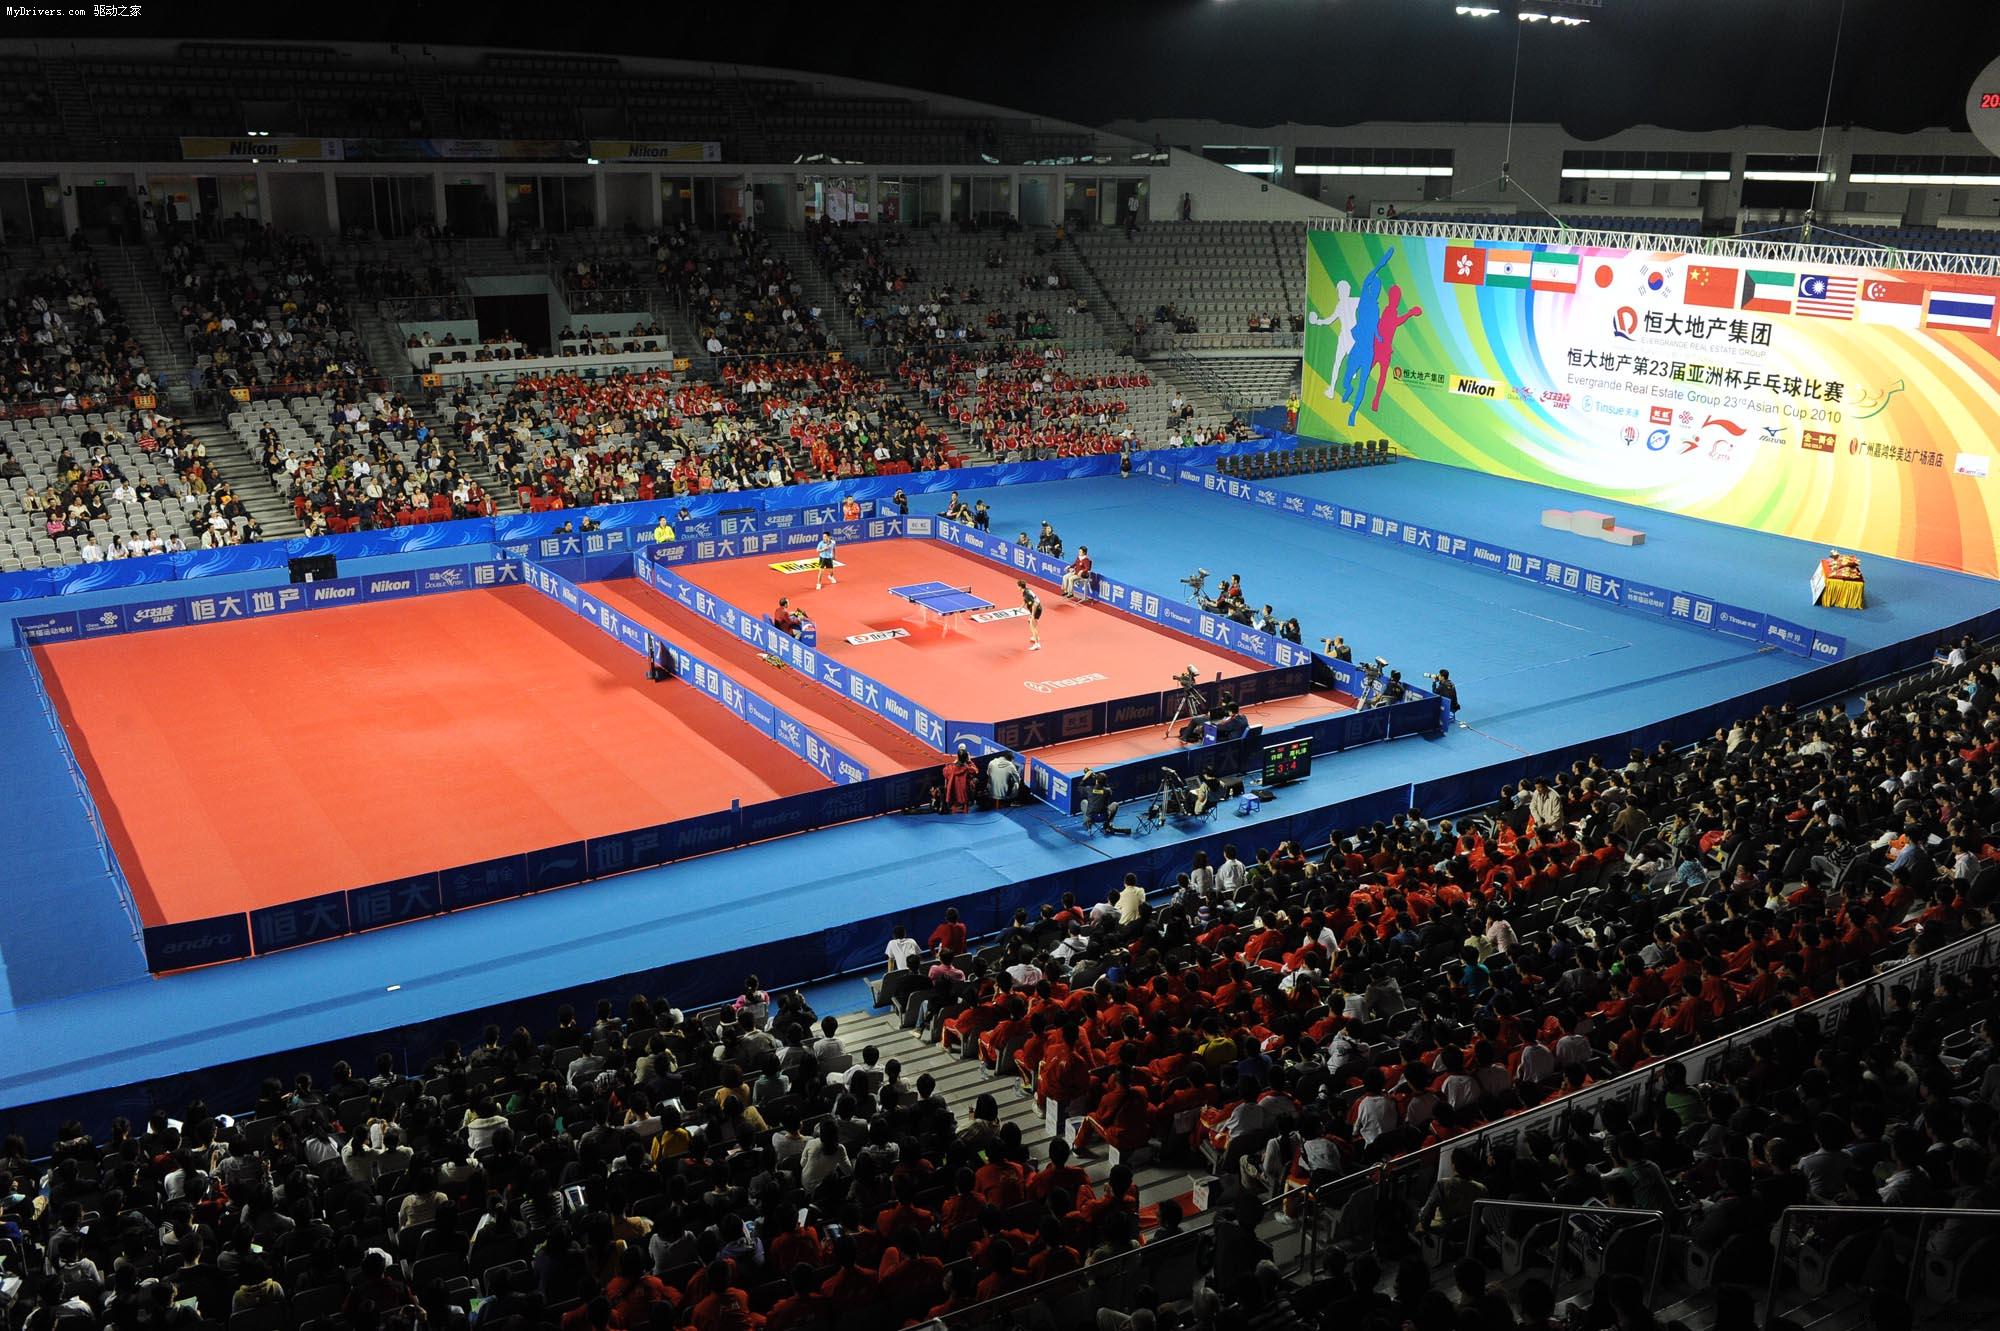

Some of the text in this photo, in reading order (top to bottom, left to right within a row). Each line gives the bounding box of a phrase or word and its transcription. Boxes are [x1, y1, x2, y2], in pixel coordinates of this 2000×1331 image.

[230, 141, 278, 156] Nikon
[628, 144, 668, 158] Nikon
[138, 185, 147, 196] A
[1261, 184, 1269, 192] B
[1377, 207, 1385, 215] C
[1644, 308, 1773, 347] 恒大地产集团
[1690, 342, 1707, 352] REAL
[1710, 345, 1737, 356] ESTATE
[1739, 348, 1767, 358] GROUP
[1403, 368, 1445, 384] 恒大地产集团
[1567, 347, 1845, 404] 恒大地产第23届亚洲杯乒乓球比赛
[1457, 378, 1496, 398] Nikon
[1567, 373, 1622, 392] Evergrande
[1625, 382, 1648, 395] Real
[1651, 385, 1684, 400] Estate
[1687, 390, 1721, 407] Group
[1747, 399, 1781, 414] Asian
[1783, 404, 1808, 420] Cup
[1811, 409, 1842, 424] 2010
[1180, 469, 1200, 483] Nikon
[1204, 474, 1226, 493] 恒大
[1228, 480, 1251, 501] 恒大
[721, 516, 757, 535] 恒大
[803, 507, 836, 527] 恒大
[869, 518, 902, 538] 恒大
[1339, 509, 1366, 529] 地产
[1371, 516, 1398, 537] 地产
[586, 531, 624, 554] 地产
[742, 533, 778, 554] 地产
[788, 533, 819, 545] Nikon
[939, 520, 960, 544] 恒大
[964, 532, 984, 550] Nikon
[1402, 525, 1431, 548] 恒大
[541, 536, 581, 557] 恒大
[697, 539, 735, 560] 恒大
[1437, 534, 1467, 555] 地产
[1474, 548, 1501, 564] Nikon
[1014, 547, 1037, 573] 恒大
[1507, 552, 1541, 575] 地产
[474, 563, 518, 584] 恒大
[540, 571, 559, 598] 恒大
[1545, 562, 1579, 588] 集团
[315, 586, 355, 601] Nikon
[371, 579, 410, 594] Nikon
[1098, 579, 1125, 603] 地产
[1585, 573, 1620, 600] 恒大
[191, 596, 243, 620] 恒大
[252, 587, 300, 613] 地产
[696, 591, 716, 620] 恒大
[1130, 590, 1159, 618] 集团
[1672, 596, 1713, 624] 集团
[133, 605, 175, 623] 红双喜
[600, 606, 619, 636] 恒大
[741, 616, 764, 646] 恒大
[869, 628, 905, 641] 恒大
[1199, 614, 1231, 645] 恒大
[767, 629, 790, 656] 地产
[1812, 638, 1839, 656] kon
[792, 643, 815, 675] 集团
[1275, 642, 1310, 667] 恒大
[694, 663, 719, 695] 集团
[722, 681, 744, 715] 恒大
[851, 674, 879, 709] 恒大
[885, 696, 909, 721] Nikon
[1115, 703, 1155, 722] Nikon
[915, 709, 943, 747] 恒大
[997, 720, 1045, 747] 恒大
[806, 734, 832, 775] 恒大
[752, 807, 801, 829] andro
[675, 823, 732, 848] Nikon
[595, 831, 658, 872] 地产
[356, 882, 433, 924] 恒大
[260, 901, 340, 946] 恒大
[161, 931, 233, 955] andro
